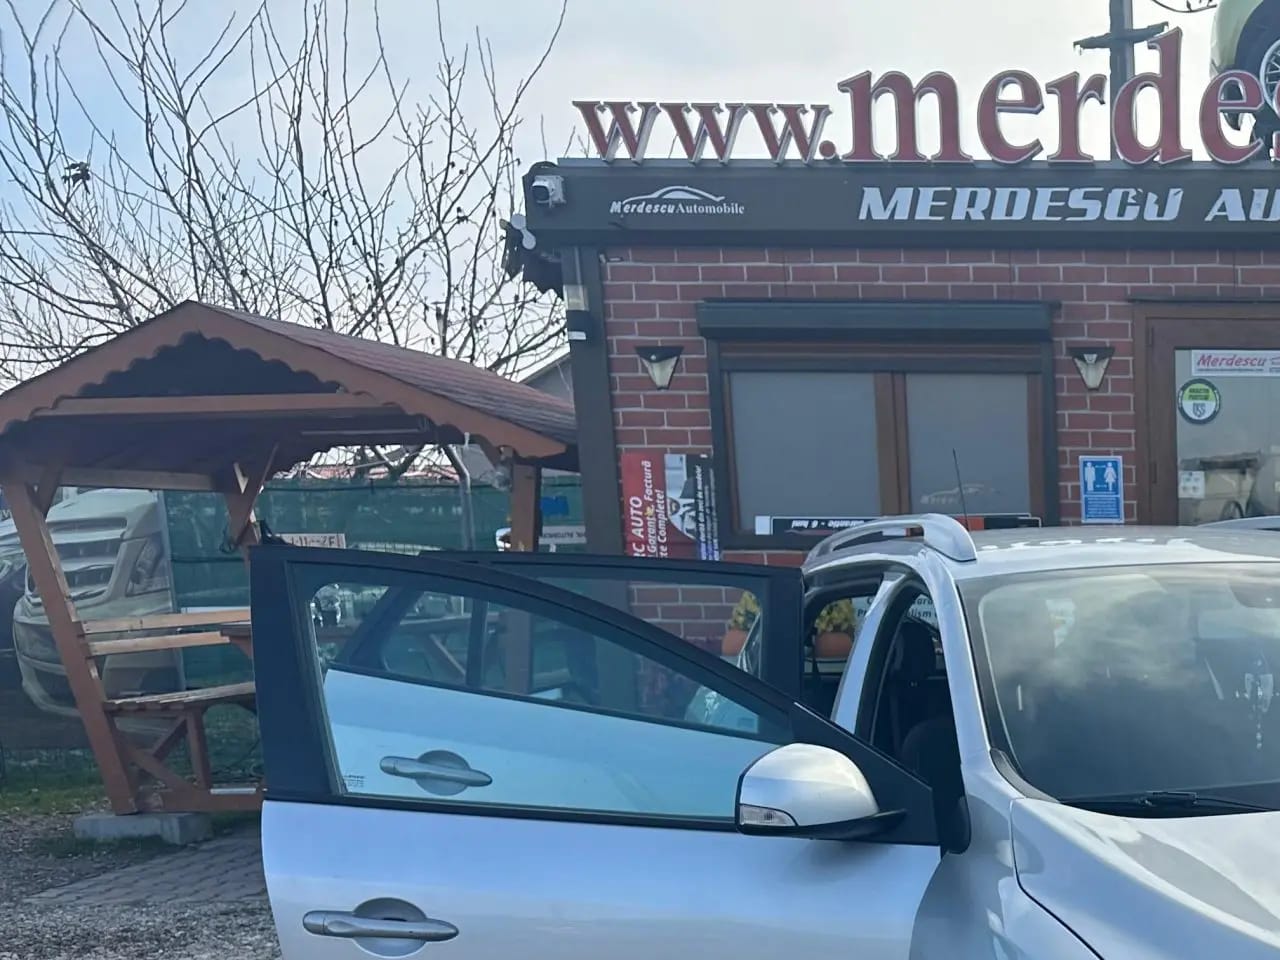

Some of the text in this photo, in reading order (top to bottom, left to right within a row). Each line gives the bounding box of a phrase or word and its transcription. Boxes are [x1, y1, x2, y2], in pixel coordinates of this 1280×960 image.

[1197, 354, 1267, 367] Merdescu
[629, 496, 645, 539] AUTO
[654, 489, 668, 543] Complete!
